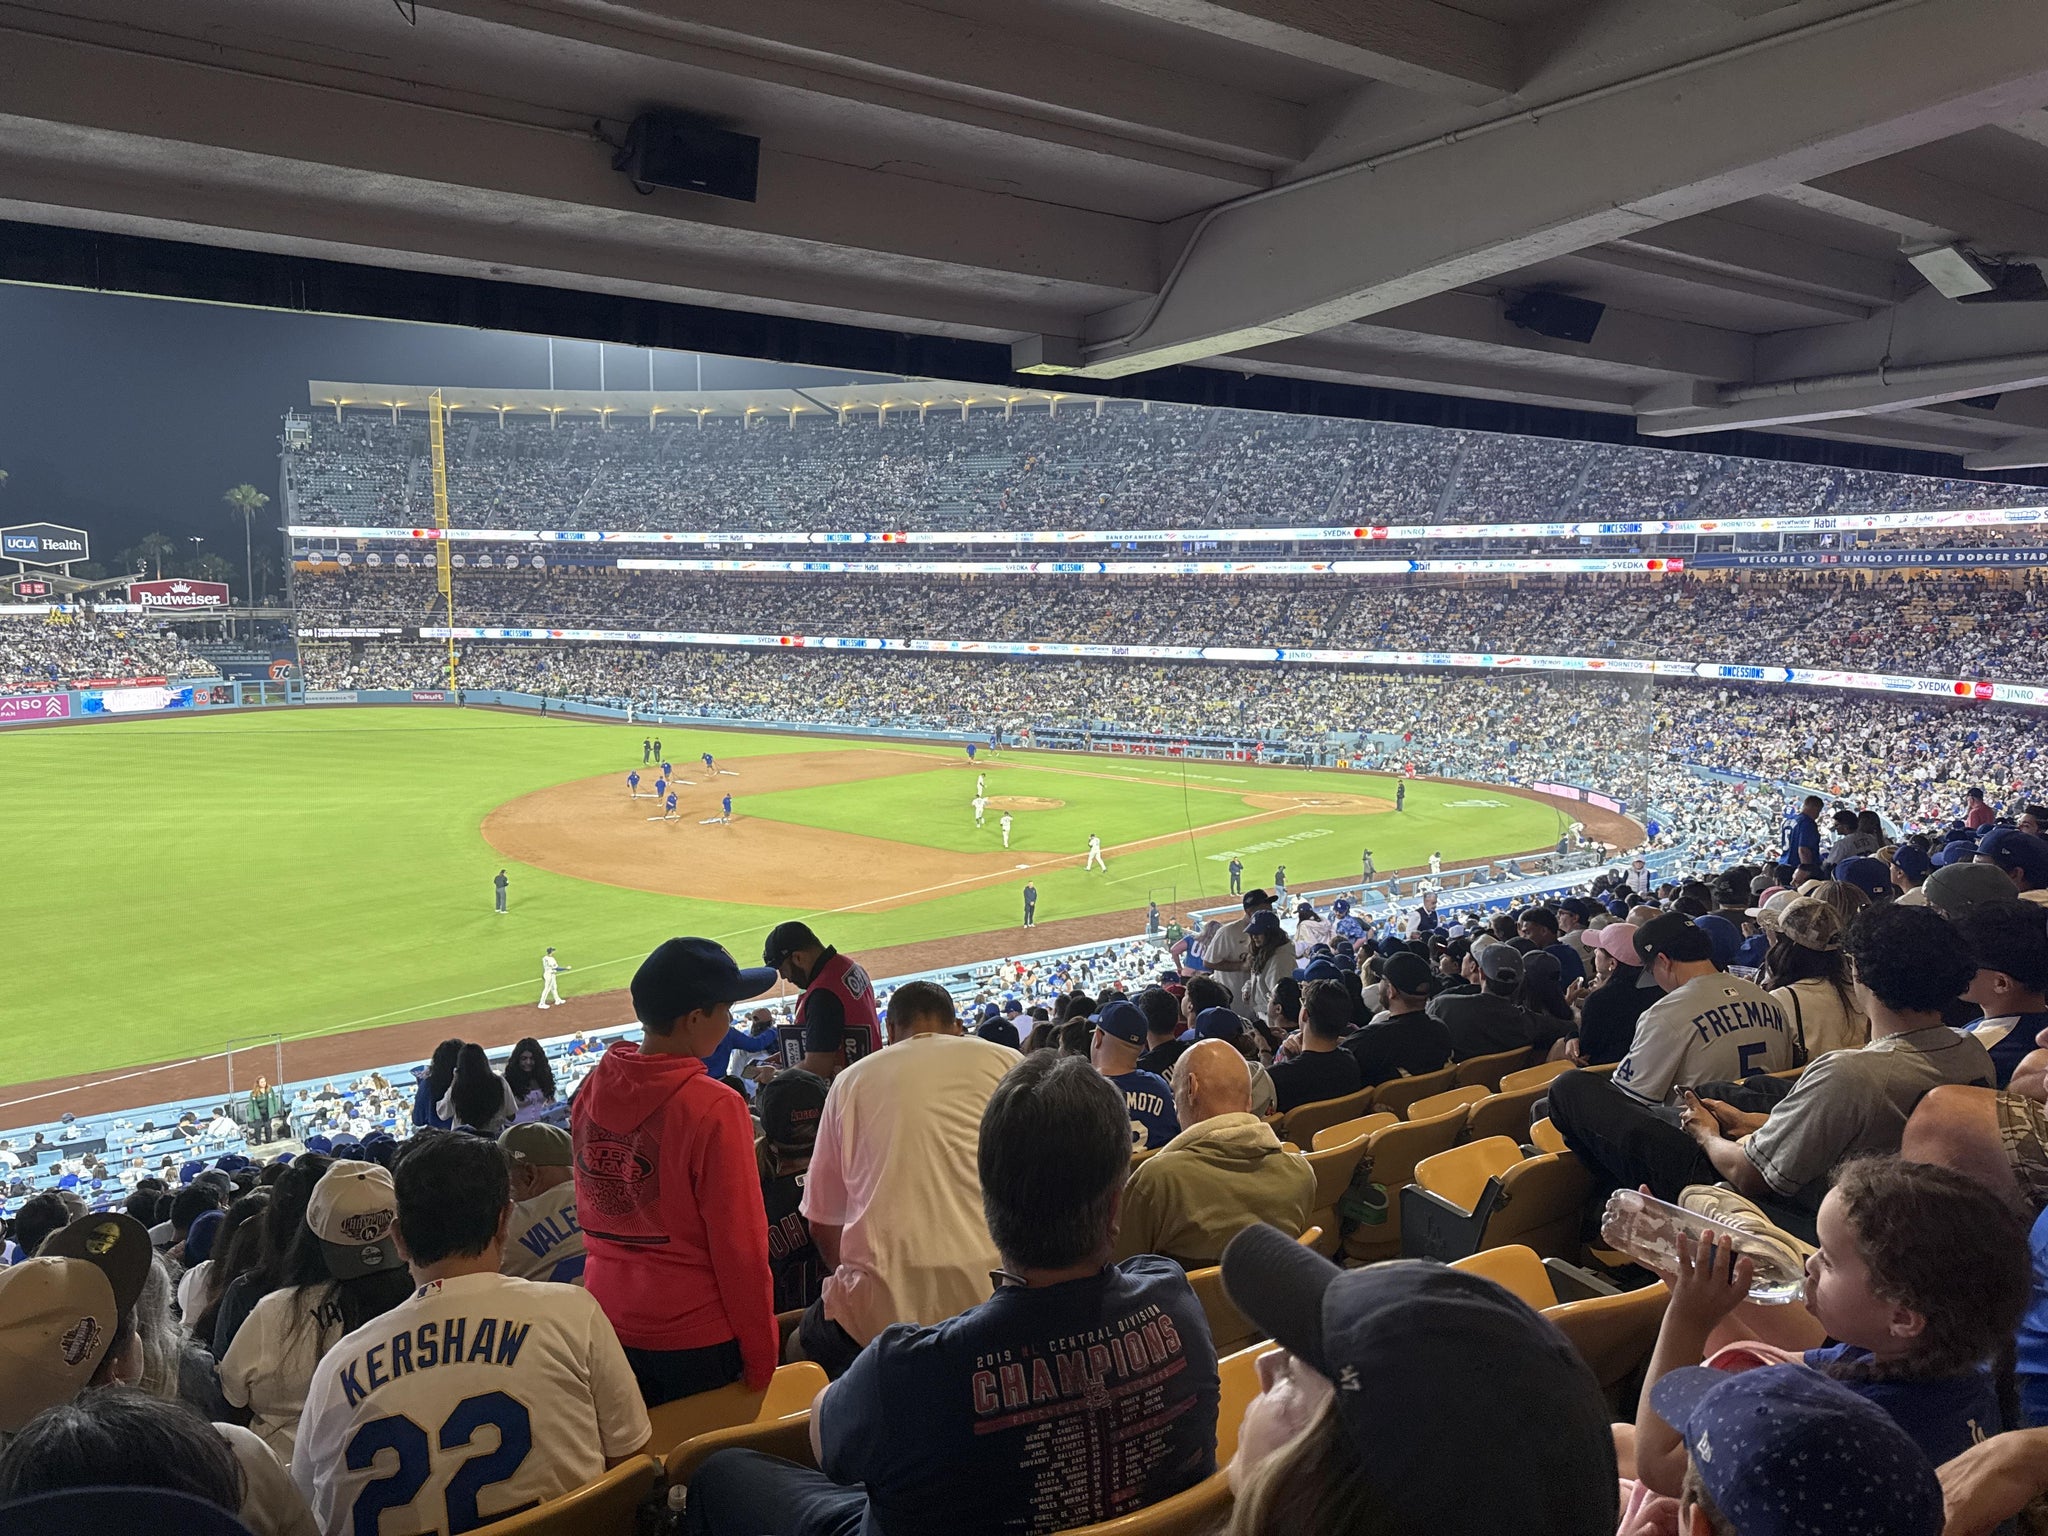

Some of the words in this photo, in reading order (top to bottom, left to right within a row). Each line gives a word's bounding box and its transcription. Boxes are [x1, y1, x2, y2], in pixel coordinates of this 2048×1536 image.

[1598, 523, 1643, 535] CONCESSIONS
[1813, 518, 1837, 529] Habit
[7, 539, 37, 549] UCLA
[41, 538, 82, 551] Health
[1612, 561, 1644, 569] SVEDKA
[1738, 555, 1795, 564] WELCOME
[1801, 555, 1816, 563] TO
[1844, 554, 1893, 563] UNIQLO
[1897, 554, 1932, 562] FIELD
[1937, 554, 1953, 562] AT
[1958, 553, 2010, 562] DODGER
[1718, 665, 1765, 679] CONCESSIONS
[1917, 680, 1952, 692] SVEDKA
[2006, 689, 2034, 700] JINRO
[413, 693, 444, 701] Yakult
[1692, 1001, 1784, 1044] FREEMAN
[1737, 1041, 1767, 1079] 5
[1126, 1091, 1164, 1116] MOTO
[518, 1205, 581, 1258] VALE
[310, 1302, 343, 1329] YA
[976, 1349, 1012, 1369] 2019
[1048, 1326, 1113, 1352] CENTRAL
[1117, 1304, 1162, 1333] DIVISION
[339, 1316, 532, 1407] KERSHAW
[971, 1313, 1183, 1414] CHAMPIONS
[344, 1390, 542, 1536] 22
